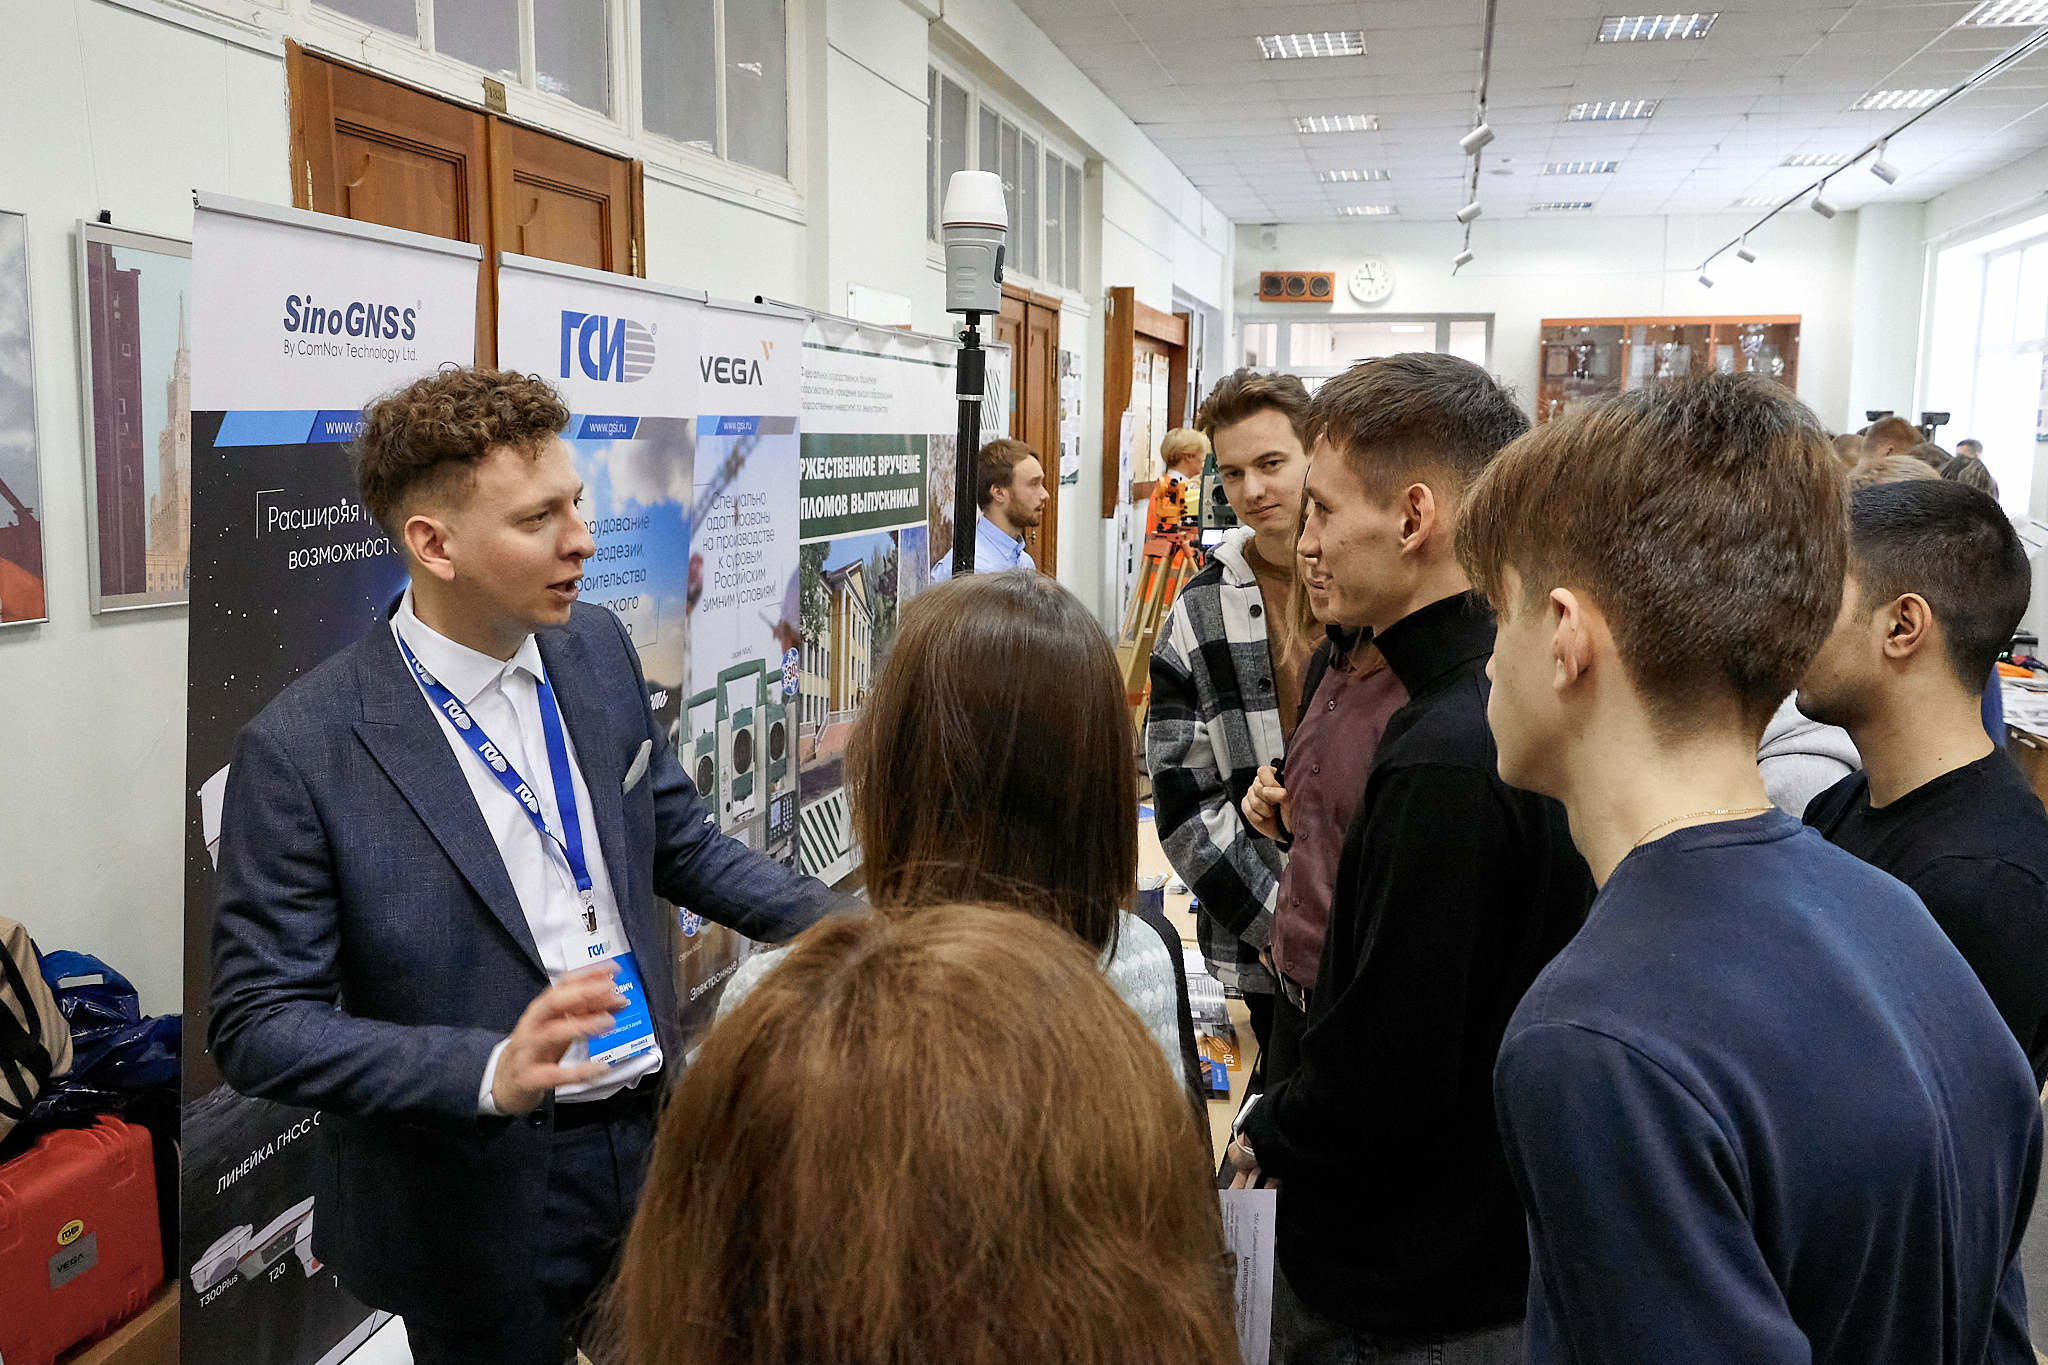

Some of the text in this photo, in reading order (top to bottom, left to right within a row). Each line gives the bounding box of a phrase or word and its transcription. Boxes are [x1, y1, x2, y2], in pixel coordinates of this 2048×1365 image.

[283, 295, 416, 340] SinoGNSS
[284, 340, 418, 362] By ComNav Technology Ltd.
[560, 310, 626, 383] ГСИ
[700, 355, 763, 385] VEGA
[589, 422, 627, 435] www.gsi.ru
[723, 421, 752, 432] www.gsi.ru
[878, 454, 921, 476] ВРУЧЕНИЕ
[712, 491, 766, 510] Специально
[800, 487, 919, 520] ПЛОМОВ ВЫПУСКНИКАМ
[268, 502, 359, 532] Расширяя
[707, 510, 771, 533] адаптированы
[703, 528, 775, 554] на производстве
[718, 550, 763, 573] к суровым
[715, 567, 766, 590] Российским
[703, 582, 776, 613] зимним условиям!
[690, 959, 738, 1001] Электронные
[216, 1117, 311, 1195] ЛИНЕЙКА ГНСС
[268, 1262, 287, 1284] T20
[199, 1274, 239, 1308] T300Plus
